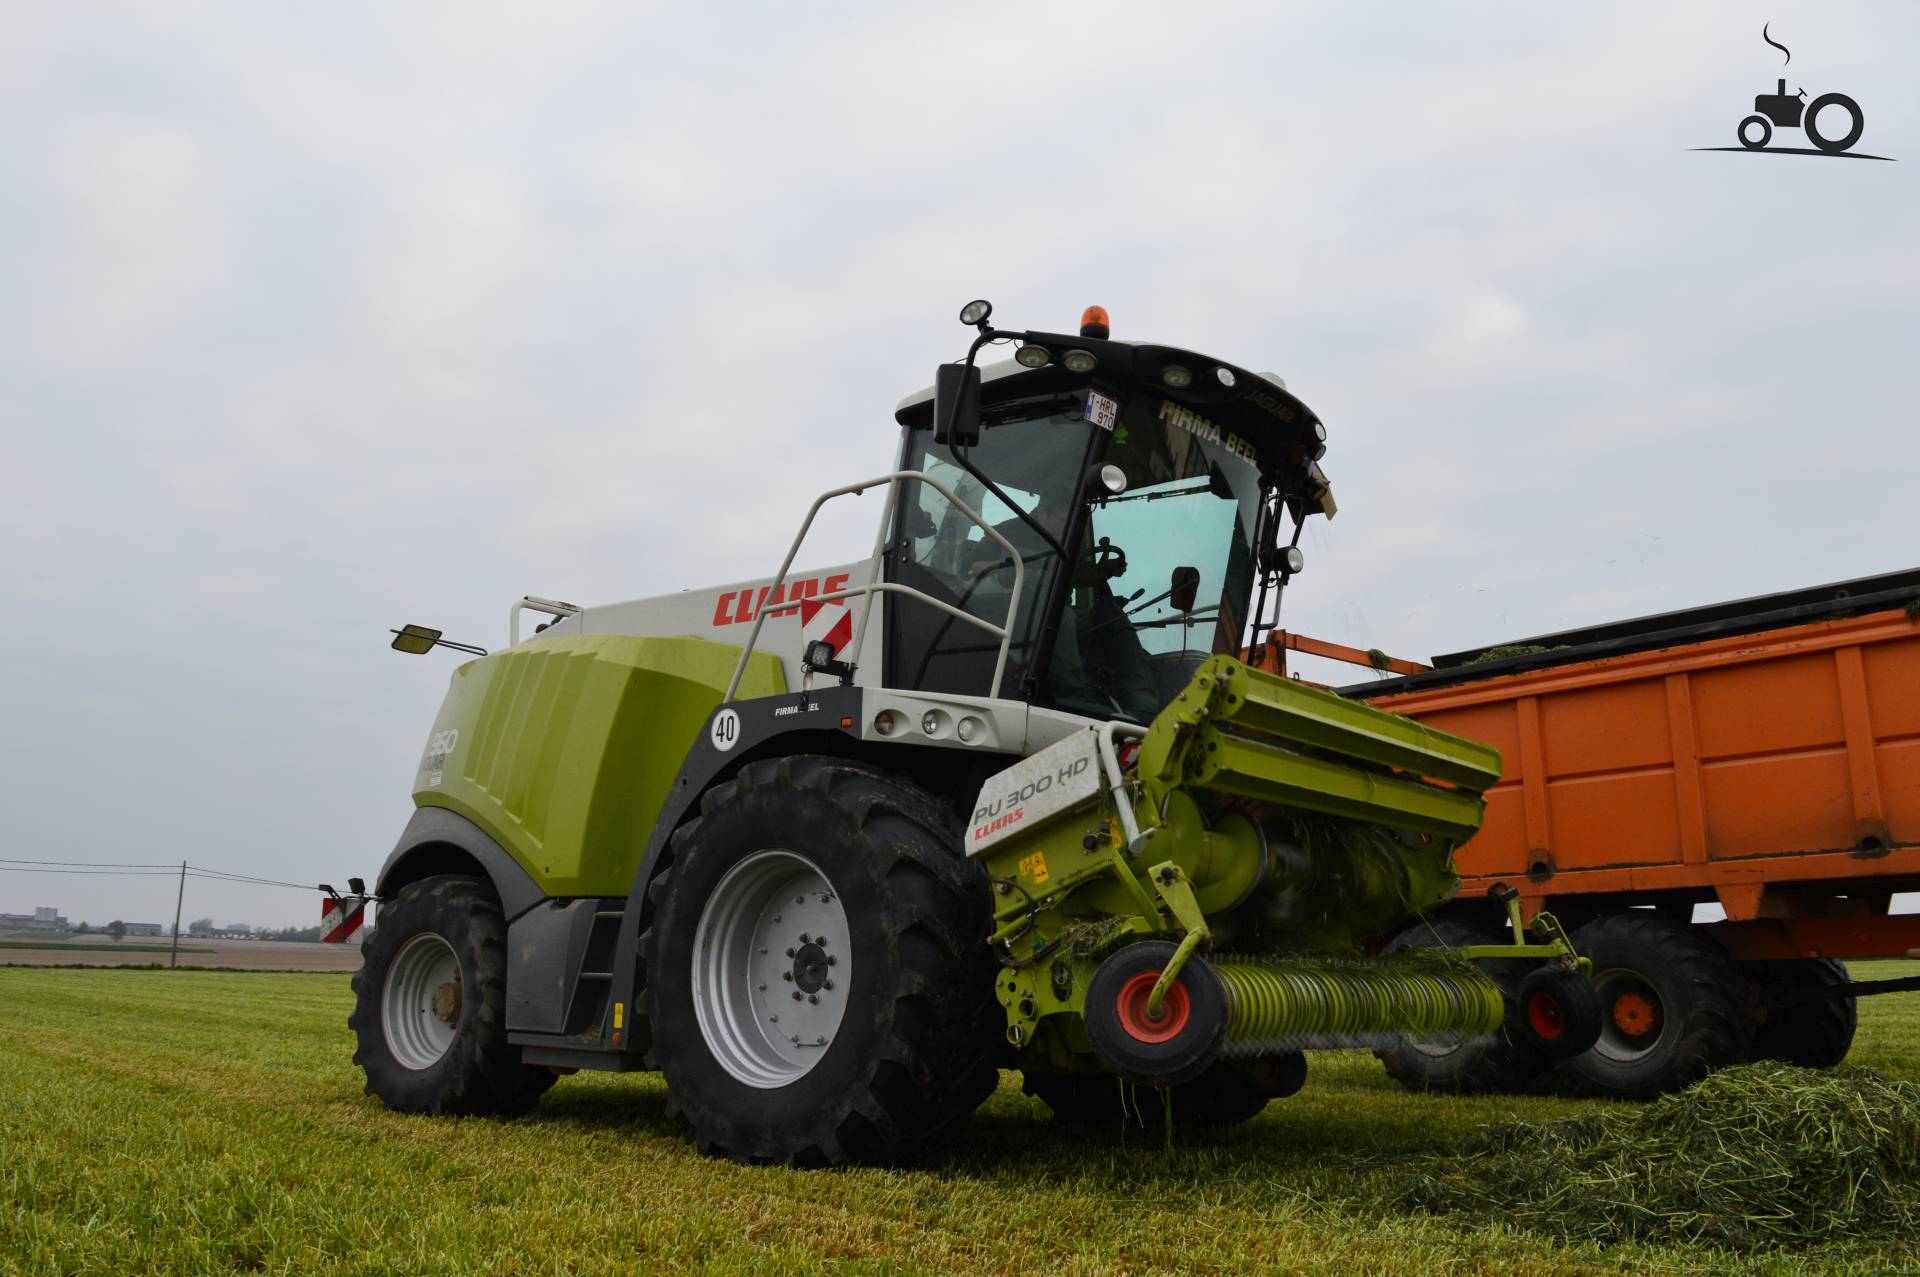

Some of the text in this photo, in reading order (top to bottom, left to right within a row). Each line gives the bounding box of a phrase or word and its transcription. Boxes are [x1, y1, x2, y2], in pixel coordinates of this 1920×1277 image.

[1090, 393, 1115, 417] 1-HRL
[1097, 411, 1114, 429] 970
[1158, 399, 1221, 446] FIRMA
[712, 573, 850, 627] CLAAS
[775, 704, 799, 716] FIRMA
[715, 715, 735, 743] 40
[974, 757, 1089, 825] PU 300 HD
[975, 807, 1024, 841] CLAAS
